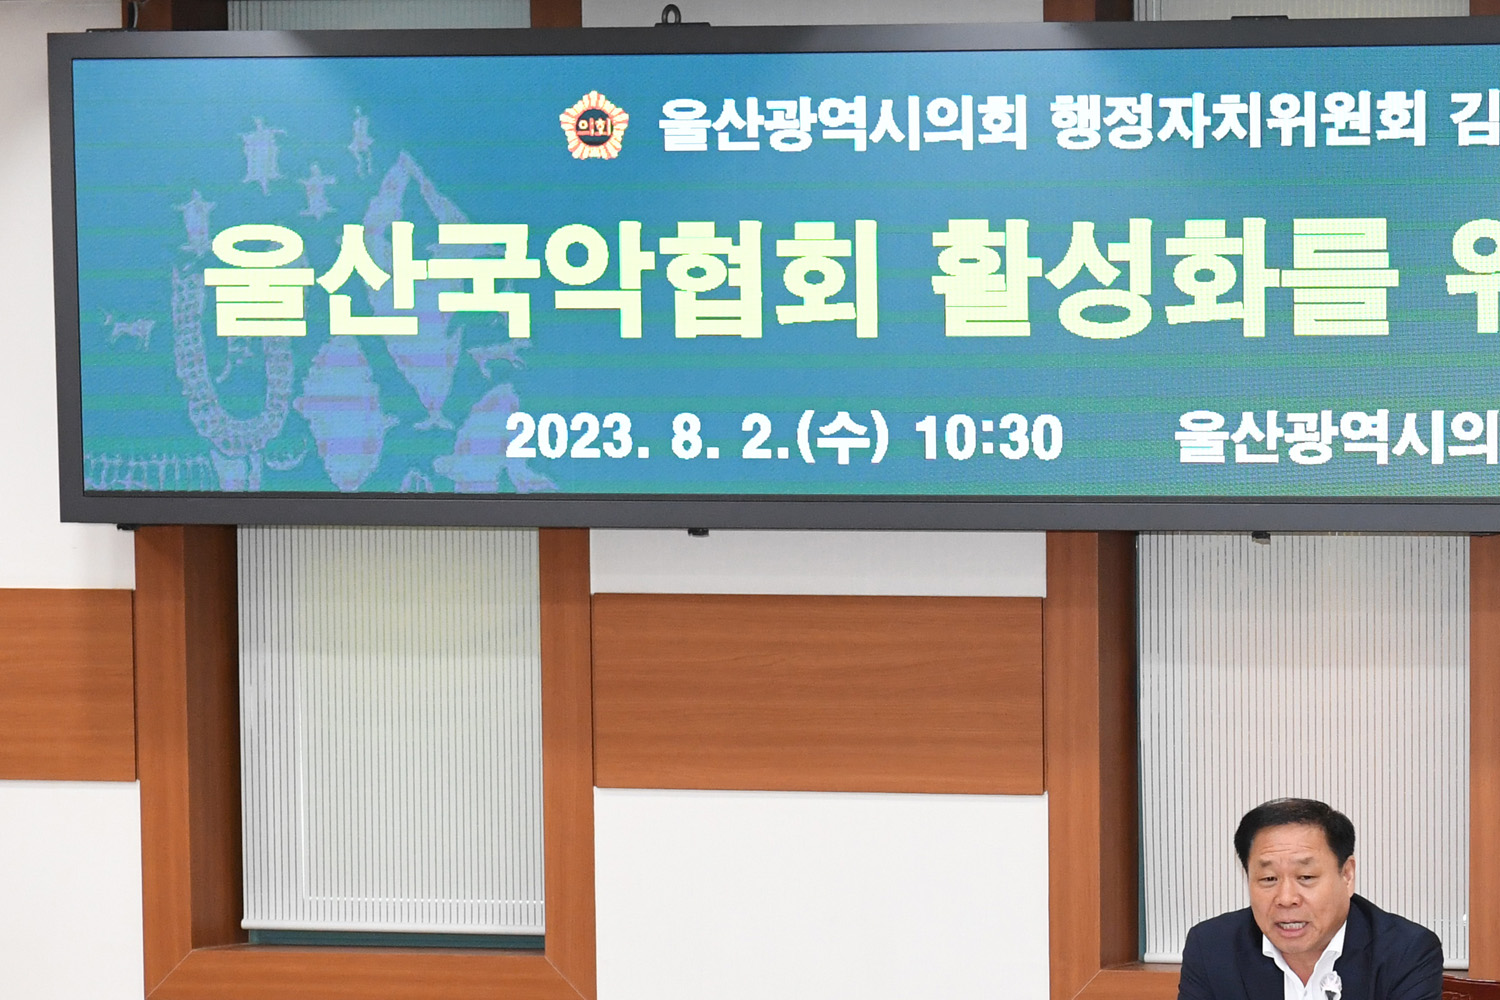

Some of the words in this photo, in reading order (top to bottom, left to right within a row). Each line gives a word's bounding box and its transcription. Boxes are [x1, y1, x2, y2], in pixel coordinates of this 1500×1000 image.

[658, 94, 1028, 152] 울산광역시의회
[1050, 88, 1428, 150] 행정자치위원회
[203, 219, 879, 340] 울산국악협회
[931, 216, 1400, 340] 활성화를
[505, 411, 650, 460] 2023.
[671, 411, 720, 461] 8.
[740, 408, 890, 466] 2.(수)
[914, 412, 1064, 462] 10:30
